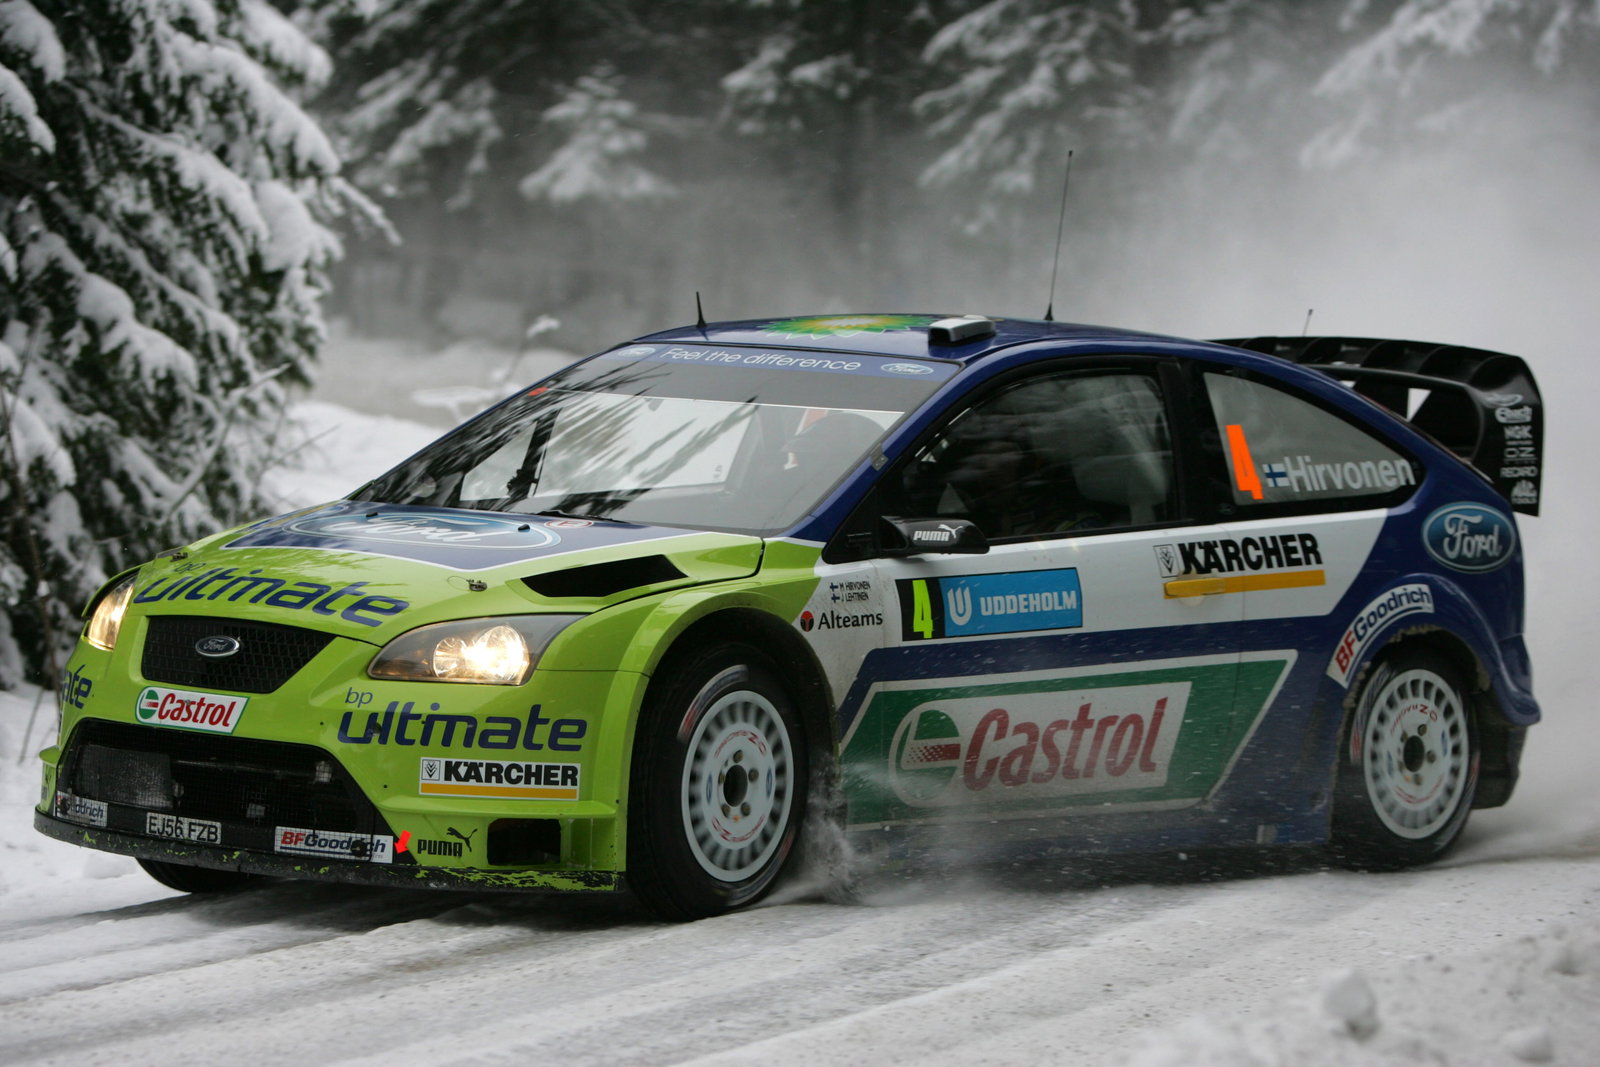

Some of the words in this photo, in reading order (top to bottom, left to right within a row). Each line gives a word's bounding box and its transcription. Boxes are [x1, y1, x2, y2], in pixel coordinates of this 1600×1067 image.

[660, 347, 708, 361] Feel
[706, 349, 742, 364] the
[744, 352, 862, 371] difference
[1226, 425, 1264, 500] 4
[1284, 455, 1416, 492] Hirvonen
[320, 516, 514, 542] Ford
[912, 530, 950, 542] PUMA
[1443, 513, 1503, 560] Ford
[1177, 533, 1322, 574] KÄRCHER
[134, 567, 409, 628] ultimate
[912, 579, 934, 639] 4
[980, 590, 1078, 617] UDDEHOLM
[818, 610, 883, 630] Alteams
[1335, 587, 1432, 675] BFGoodrich
[158, 693, 236, 727] Castrol
[345, 687, 373, 708] bp
[338, 701, 587, 752] ultimate
[963, 696, 1169, 792] Castrol
[444, 760, 578, 787] KÄRCHER
[56, 795, 103, 818] odrich
[148, 816, 184, 838] EJ56
[188, 822, 218, 842] FZB
[280, 830, 386, 853] BFGoodh
[417, 840, 463, 858] PUMA
